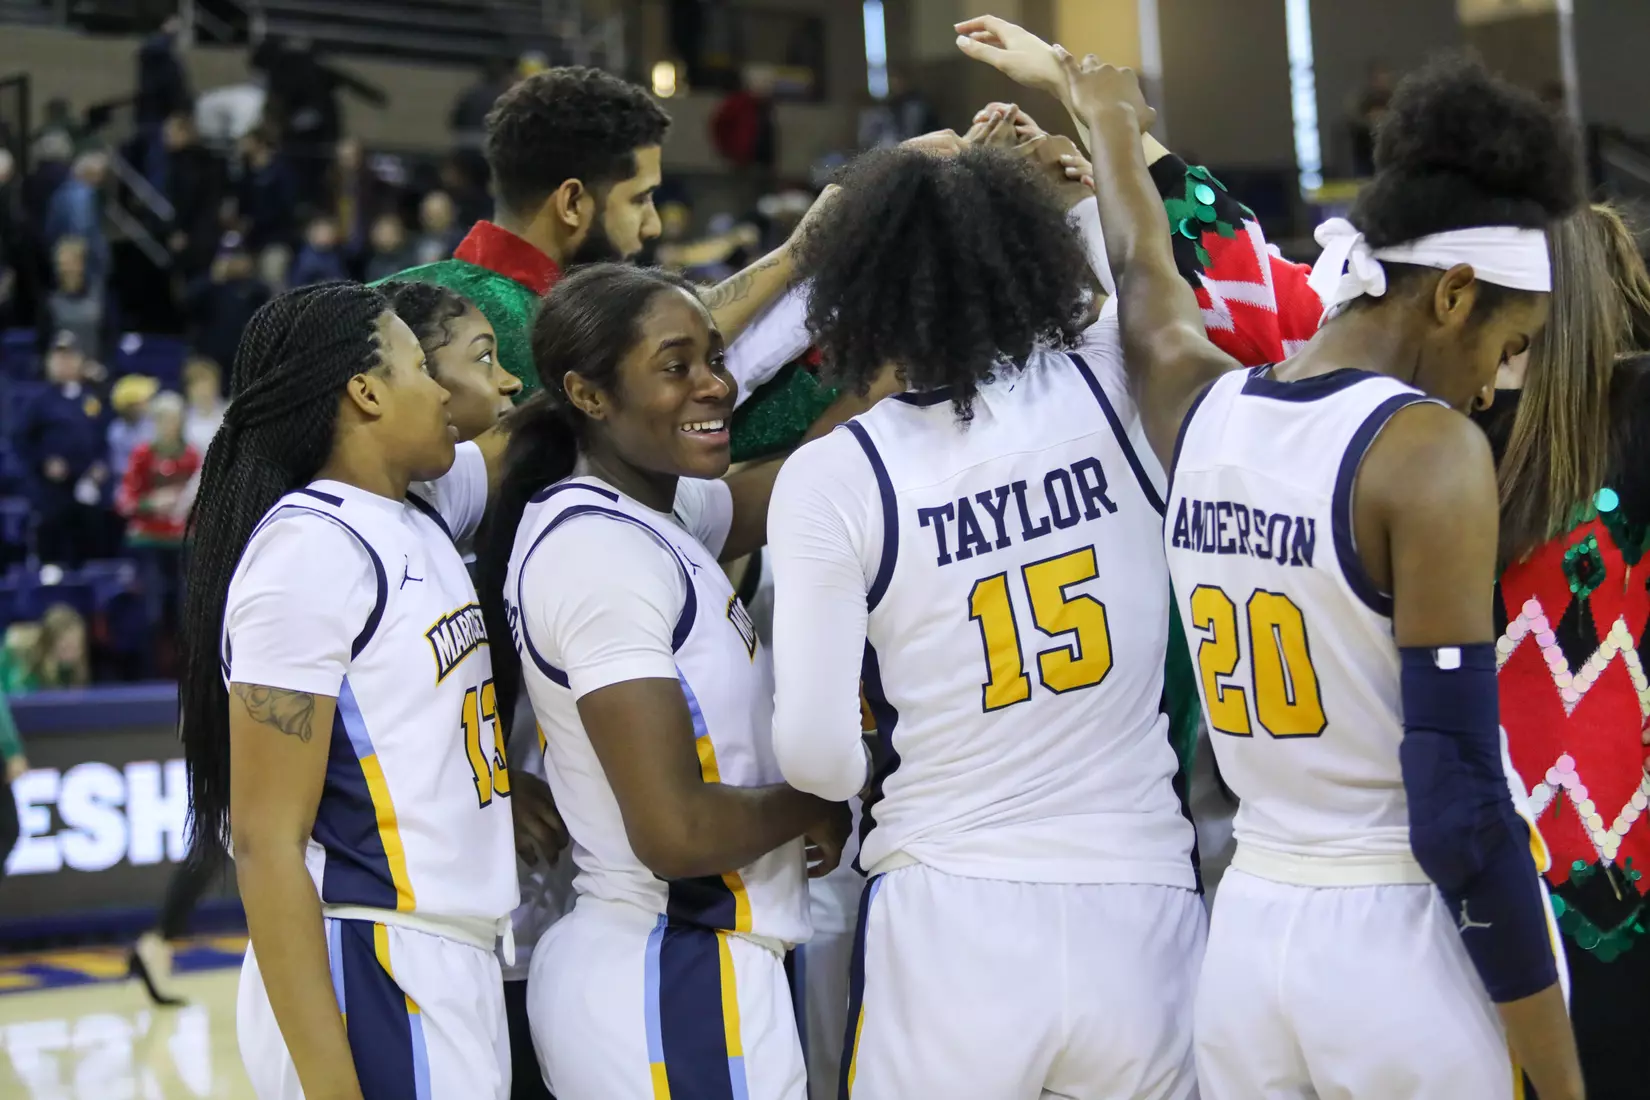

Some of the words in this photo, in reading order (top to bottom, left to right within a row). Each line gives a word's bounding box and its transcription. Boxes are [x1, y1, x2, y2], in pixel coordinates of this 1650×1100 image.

[917, 456, 1118, 567] TAYLOR
[1172, 497, 1315, 567] ANDERSON
[967, 544, 1113, 713] 15
[1190, 583, 1328, 739] 20
